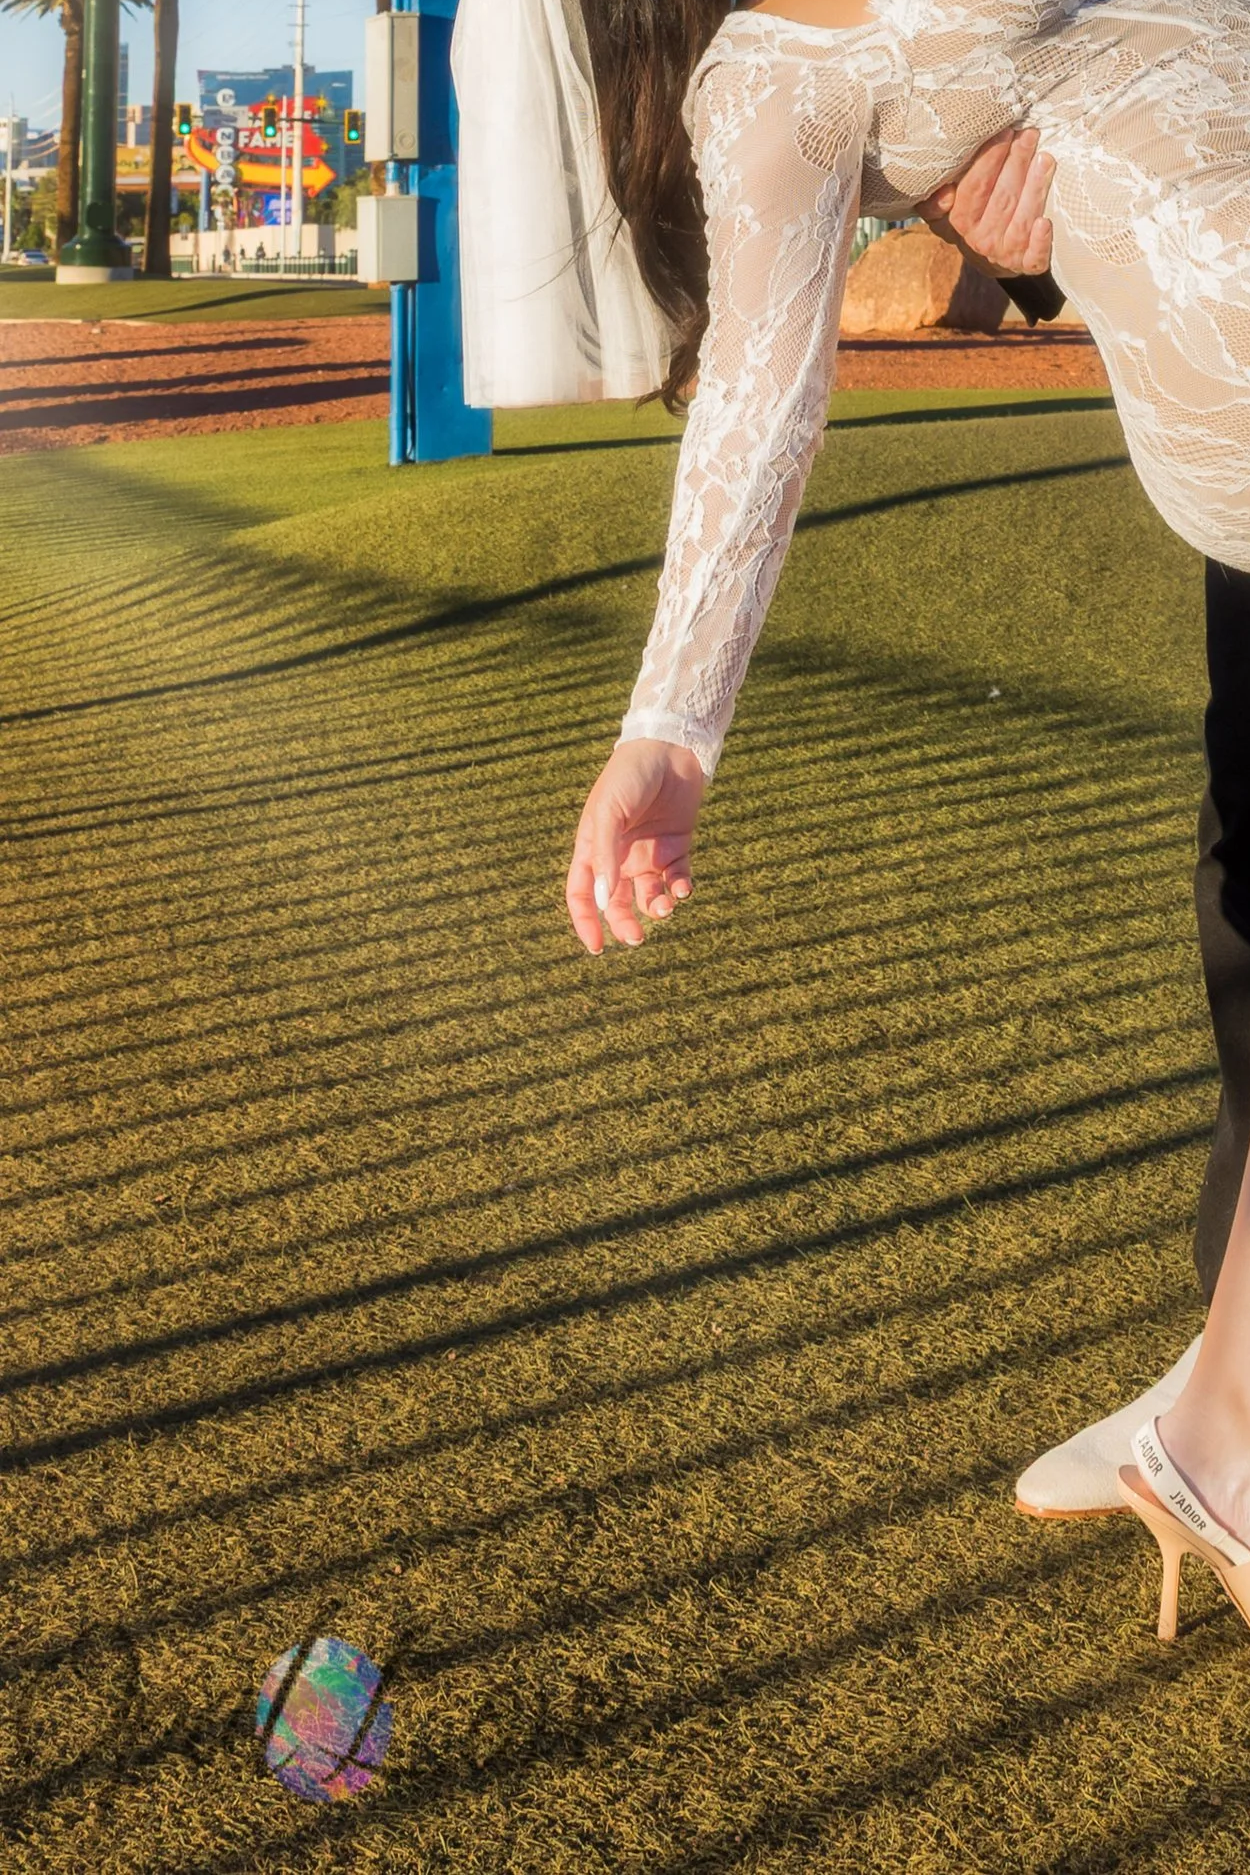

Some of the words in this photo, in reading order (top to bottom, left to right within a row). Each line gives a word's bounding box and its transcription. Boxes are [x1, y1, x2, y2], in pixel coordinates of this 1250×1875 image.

[238, 131, 294, 149] FAME
[1138, 1435, 1163, 1477] J'ADIOR
[1169, 1490, 1207, 1531] J'ADIOR
